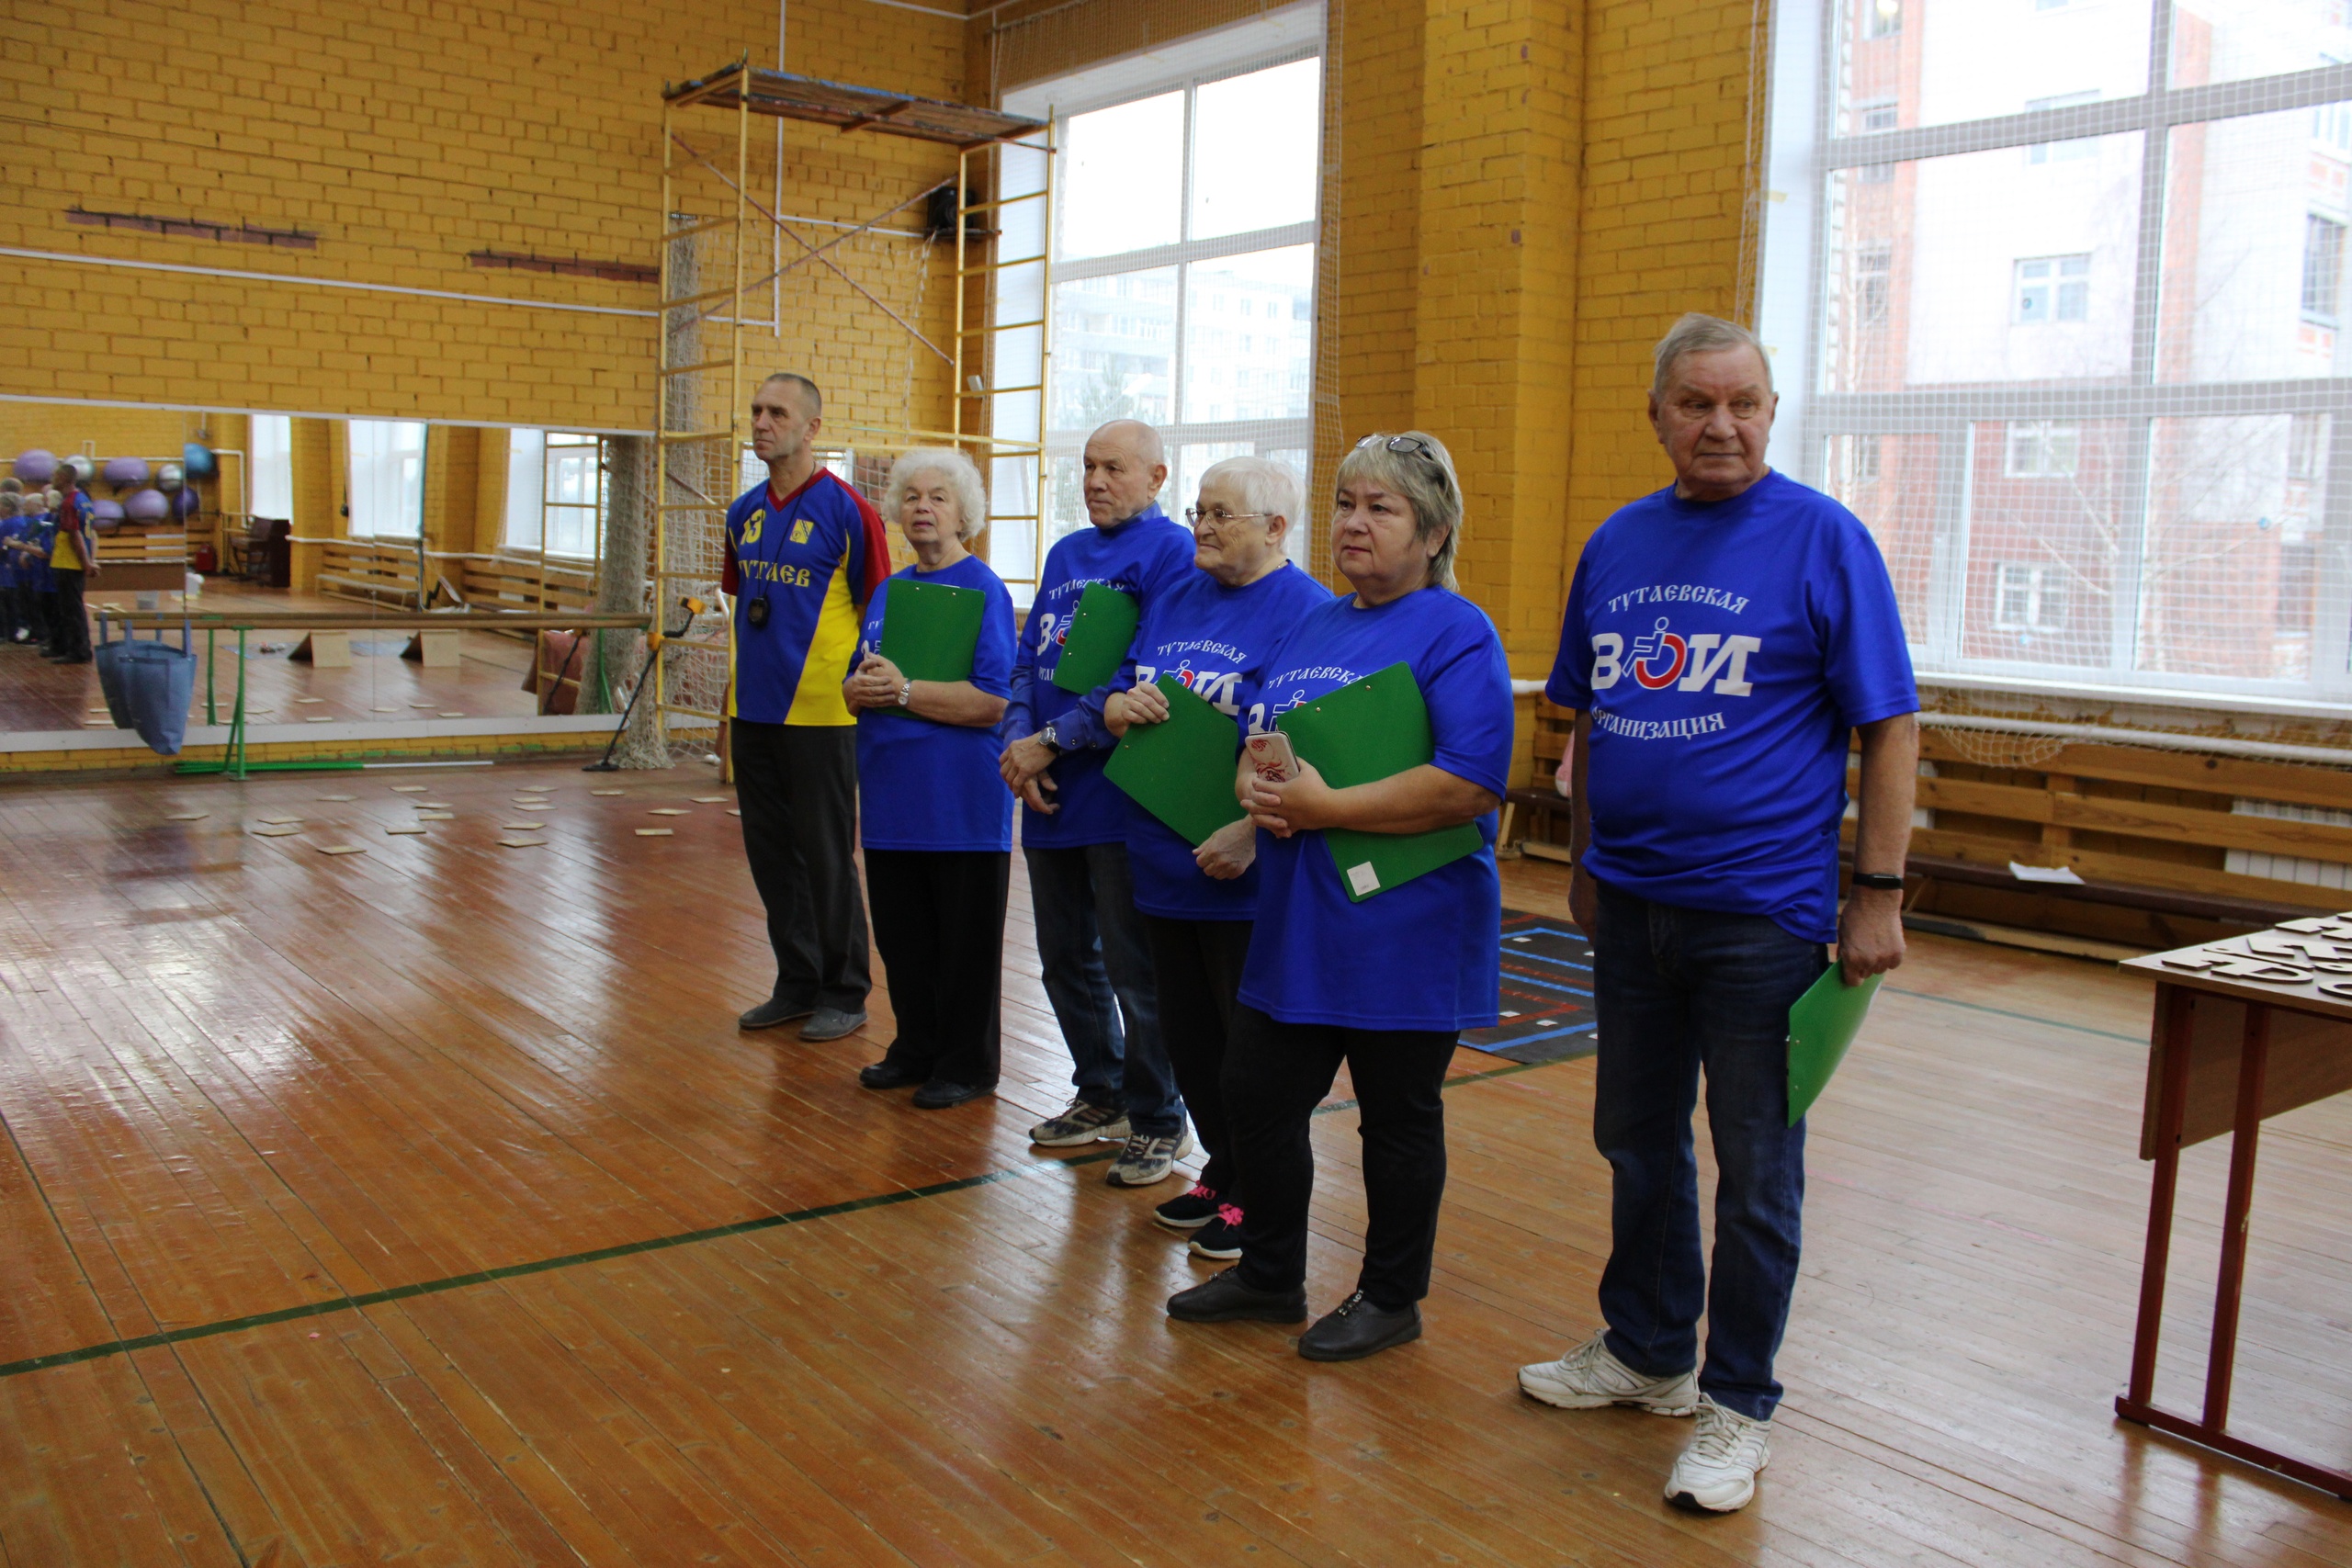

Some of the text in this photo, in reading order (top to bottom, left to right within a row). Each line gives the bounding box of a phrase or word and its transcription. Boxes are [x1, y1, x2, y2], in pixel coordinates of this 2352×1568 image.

[740, 509, 766, 546] 13
[1609, 584, 1750, 615] ТУТАЕВСКАЯ
[1158, 639, 1247, 664] ТУТАЕВСКАЯ
[1590, 632, 1762, 697] ВОИ
[1268, 666, 1370, 690] ТУТАЕВСКА
[1591, 706, 1726, 740] ОРГАНИЗАЦИЯ
